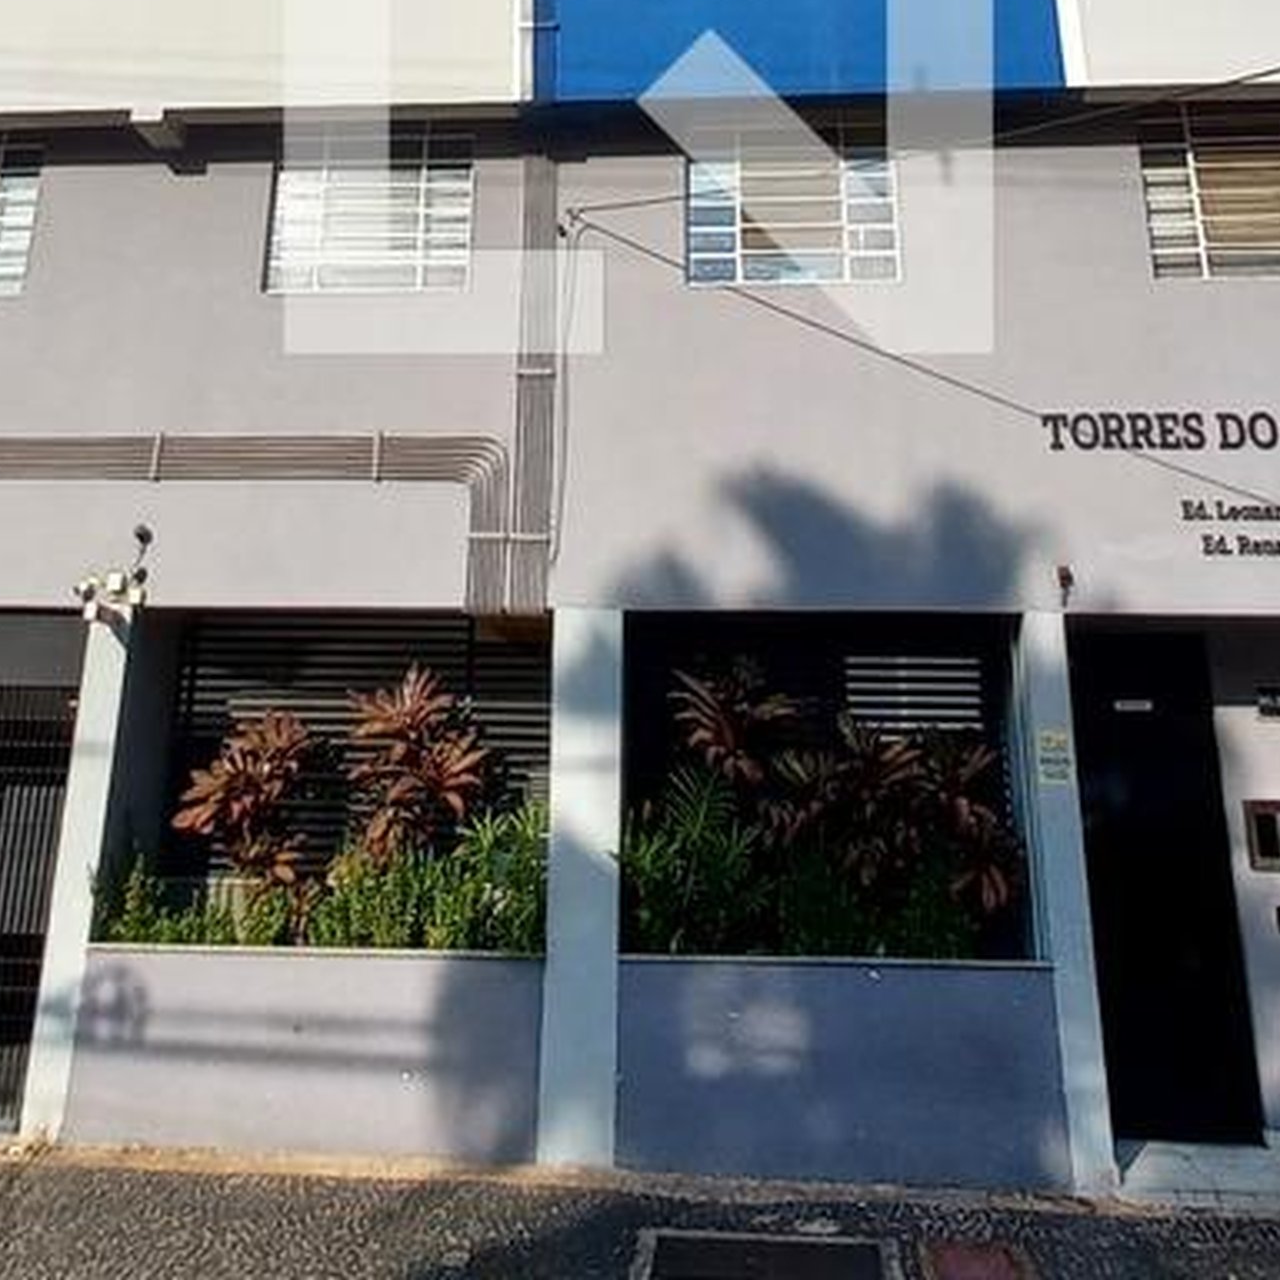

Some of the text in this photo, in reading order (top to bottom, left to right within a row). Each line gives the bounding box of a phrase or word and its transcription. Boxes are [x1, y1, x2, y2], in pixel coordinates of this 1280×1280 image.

[1041, 412, 1206, 451] TORRES
[1216, 412, 1279, 451] DO
[1181, 500, 1213, 521] Ed.
[1202, 535, 1232, 556] Ed.
